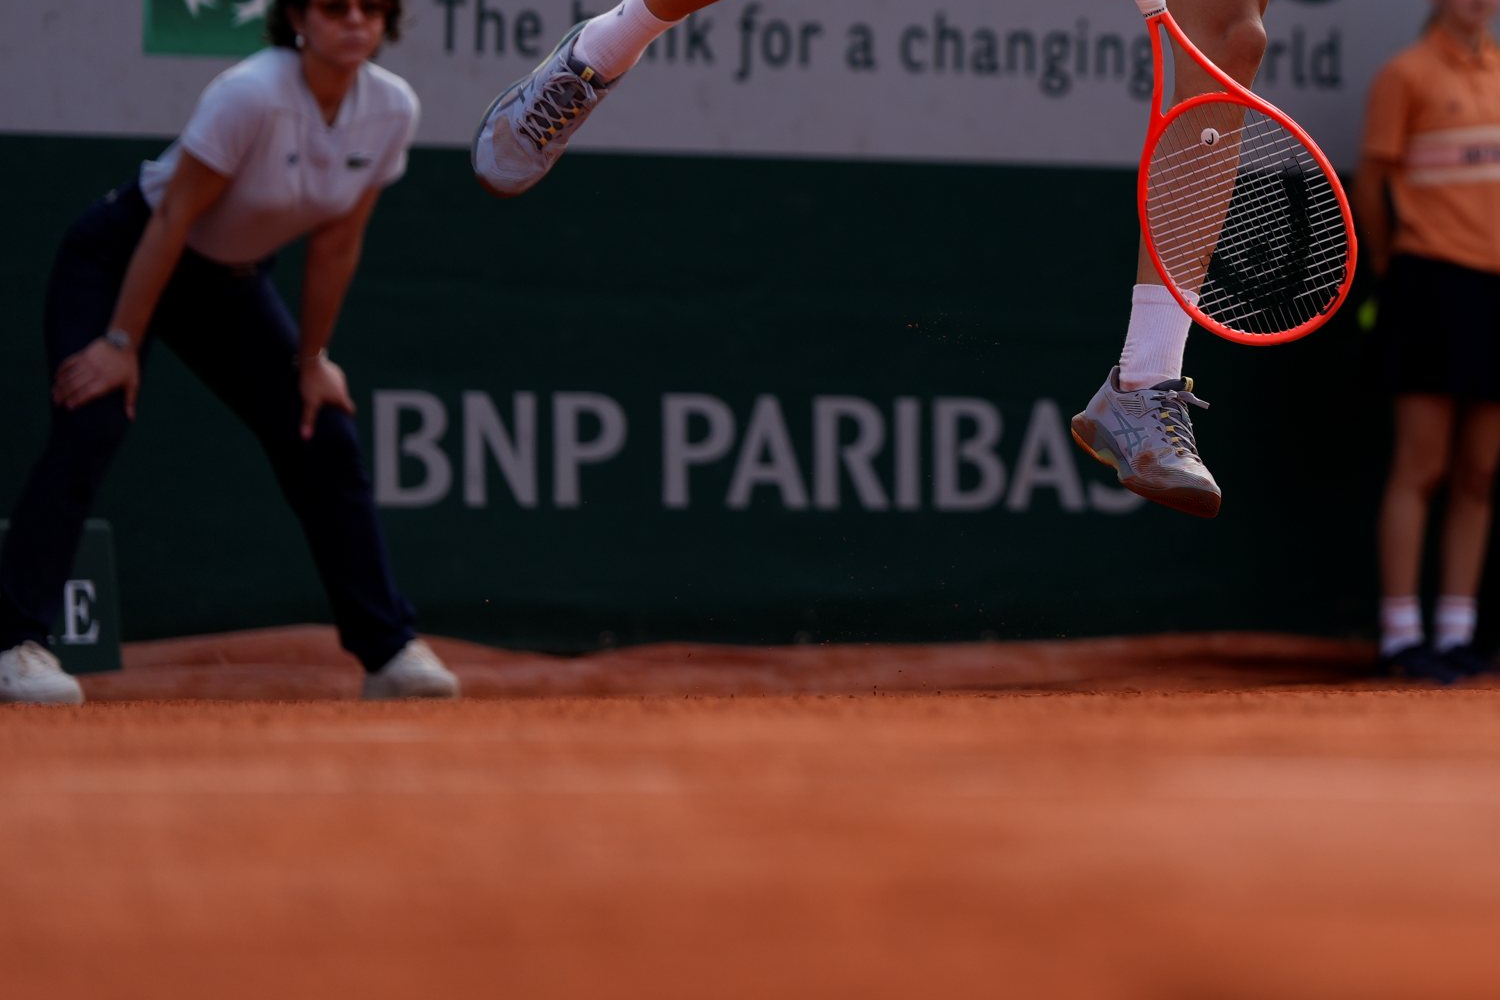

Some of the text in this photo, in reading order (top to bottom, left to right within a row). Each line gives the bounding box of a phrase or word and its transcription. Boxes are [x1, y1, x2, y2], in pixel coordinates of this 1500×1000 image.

[734, 1, 823, 84] for
[845, 21, 875, 71] a
[899, 11, 1151, 101] changing
[371, 388, 1145, 514] BNP PARIBA
